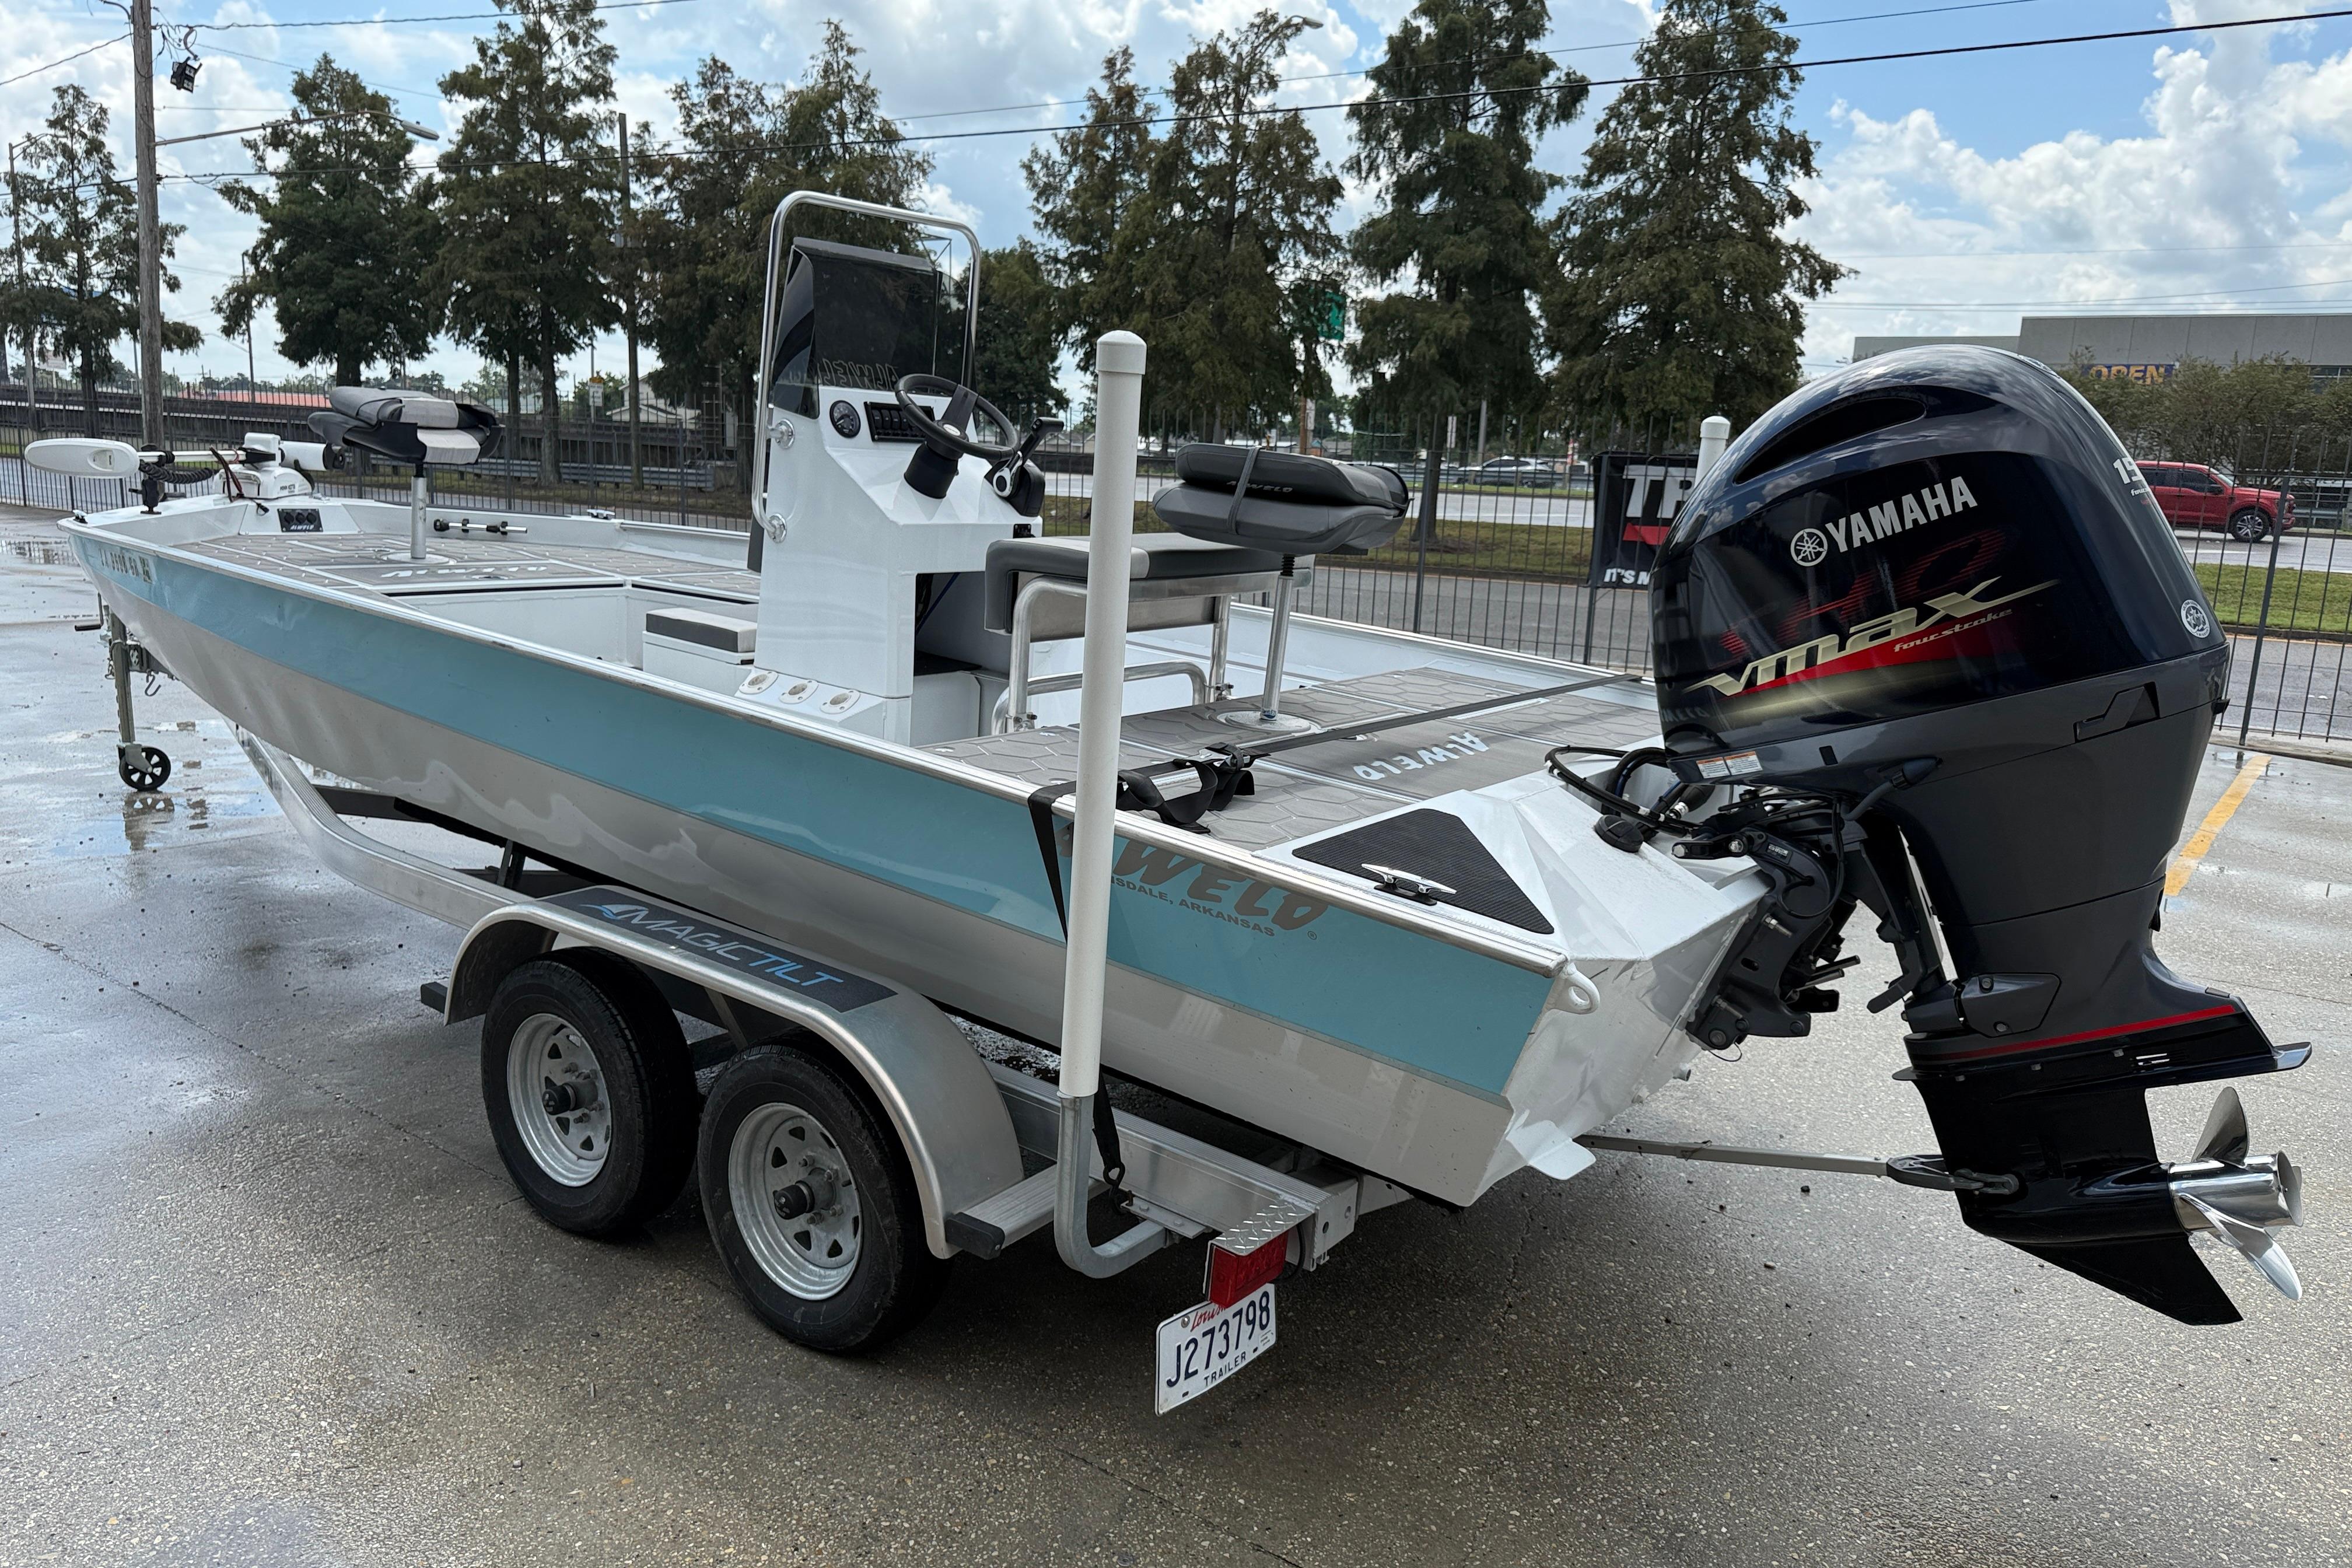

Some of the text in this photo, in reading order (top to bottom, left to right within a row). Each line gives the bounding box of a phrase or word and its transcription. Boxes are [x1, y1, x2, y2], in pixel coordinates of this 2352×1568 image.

[2090, 365, 2165, 384] OPEN
[1226, 481, 1293, 493] AWELD
[1825, 476, 1978, 554] YAMAHA
[1604, 568, 1636, 584] IT'S
[1353, 732, 1489, 780] ALWELD
[1054, 821, 1328, 930] AWELD
[1111, 876, 1275, 937] SDALE, ARKANSAS
[623, 909, 844, 986] MAGICTILT
[1166, 1290, 1270, 1388] J273798
[1203, 1350, 1247, 1387] TRAILER
